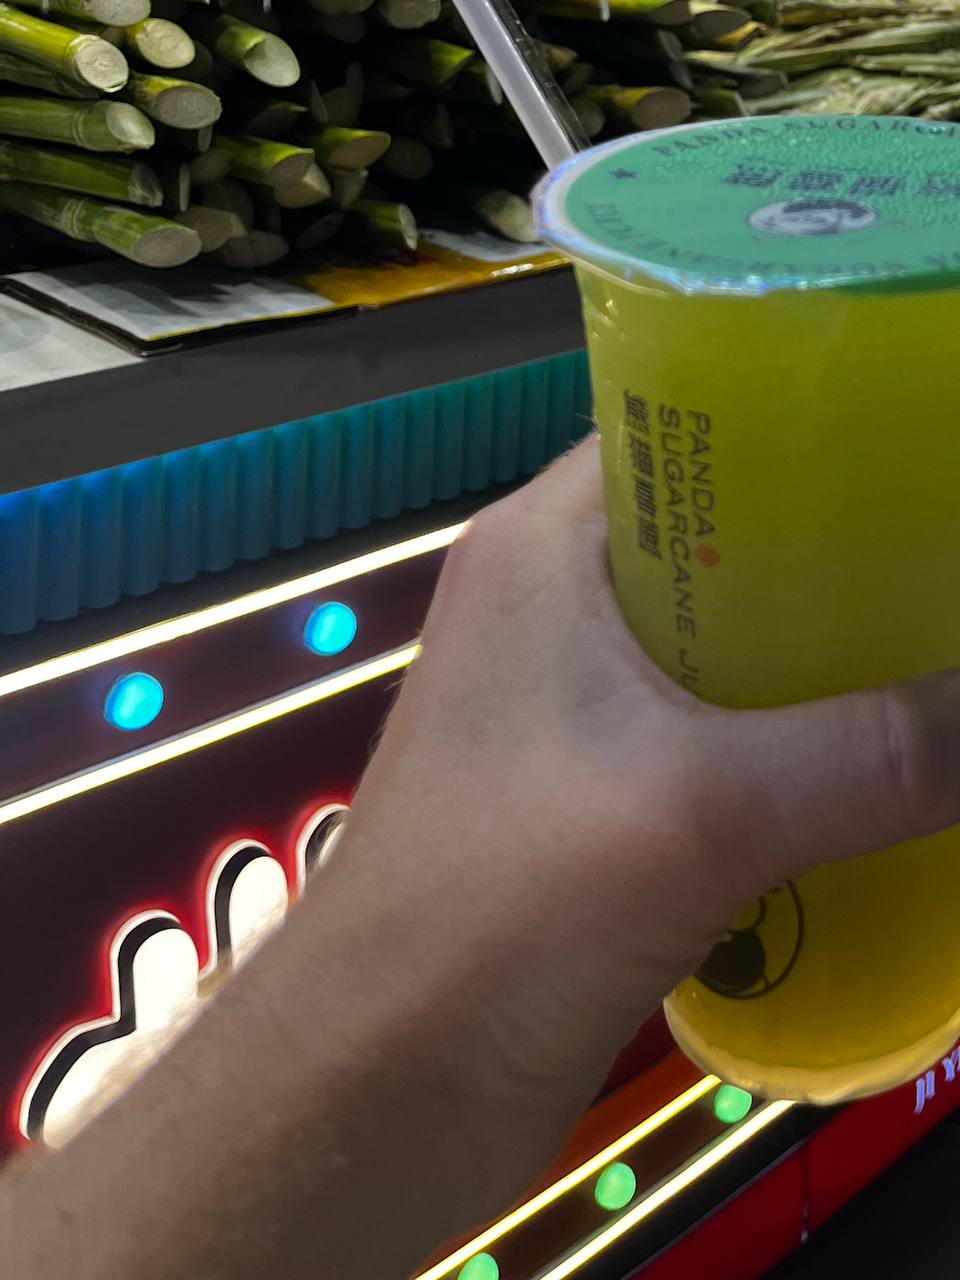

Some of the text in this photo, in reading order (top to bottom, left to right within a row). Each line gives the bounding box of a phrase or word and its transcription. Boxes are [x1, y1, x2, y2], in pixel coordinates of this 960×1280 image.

[658, 402, 697, 639] SUGARCANE
[686, 408, 716, 538] PANDA
[914, 1070, 936, 1115] JI
